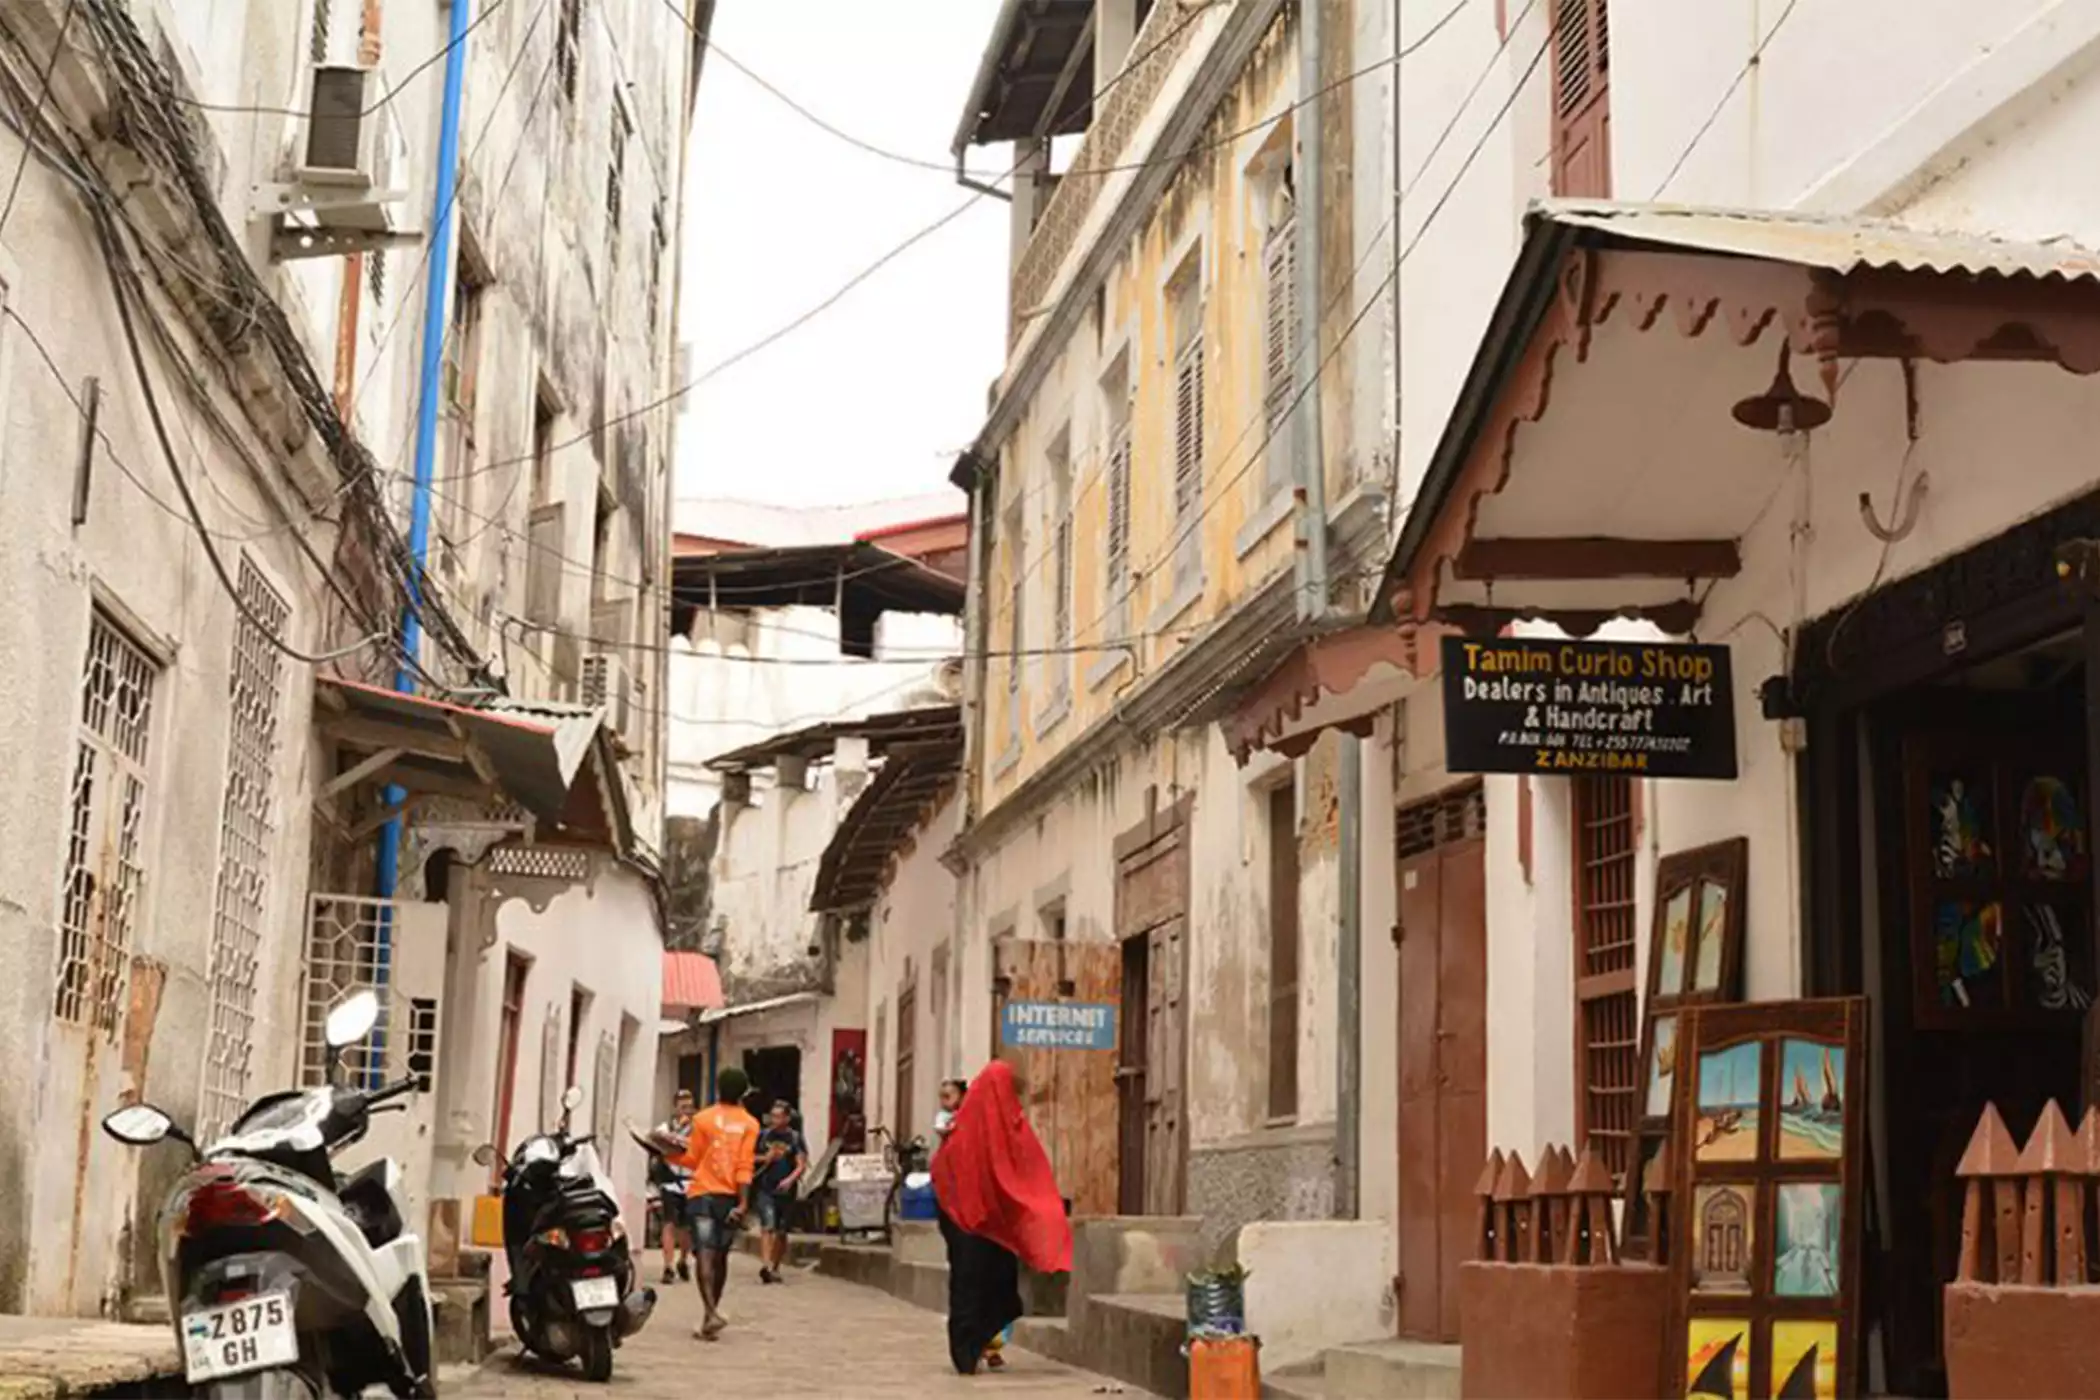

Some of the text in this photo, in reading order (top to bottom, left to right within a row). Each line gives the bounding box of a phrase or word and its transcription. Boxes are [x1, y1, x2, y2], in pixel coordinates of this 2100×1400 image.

[1462, 643, 1713, 683] Tamim Curio Shop
[1463, 675, 1547, 702] Dealers
[1554, 677, 1573, 703] in
[1680, 683, 1712, 705] Art
[1523, 703, 1653, 732] & Handcraft
[1535, 749, 1648, 769] ZANZIBAR
[1008, 1003, 1106, 1028] INTERNET
[222, 1336, 258, 1366] GH
